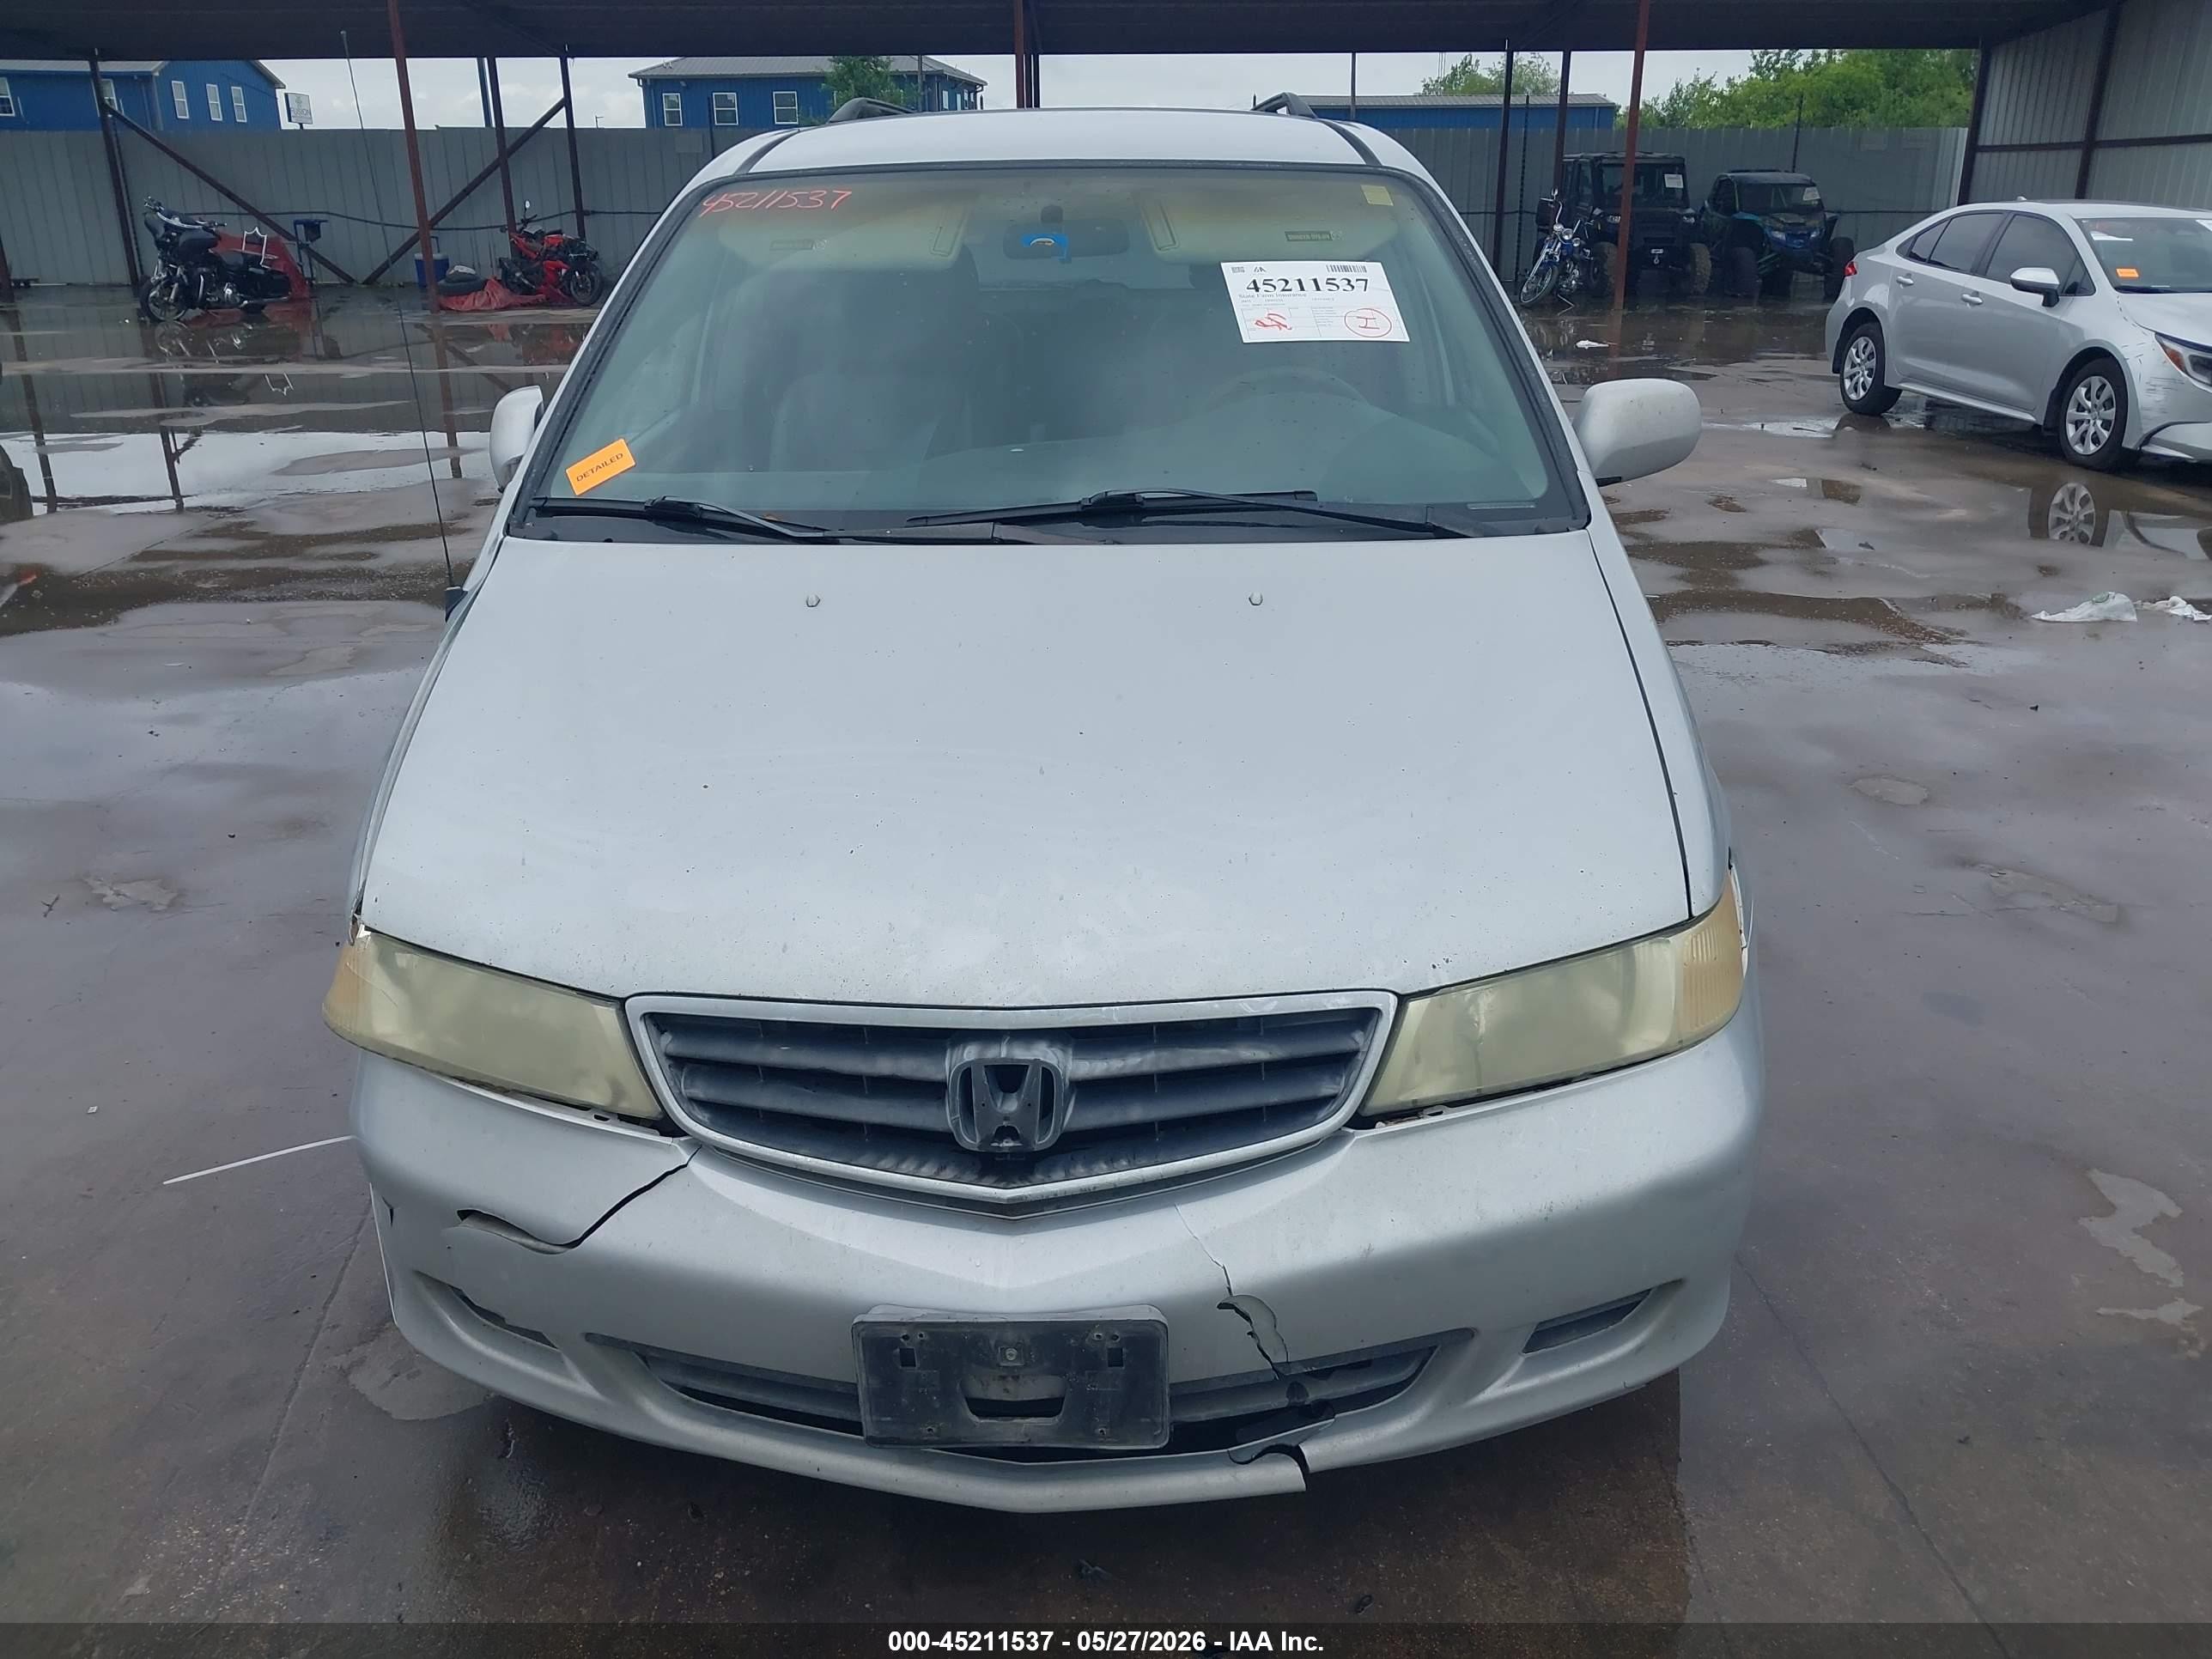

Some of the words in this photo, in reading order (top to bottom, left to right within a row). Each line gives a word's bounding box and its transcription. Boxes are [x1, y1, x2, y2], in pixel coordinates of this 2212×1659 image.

[699, 190, 853, 218] 45211537
[1246, 277, 1369, 293] 45211537
[576, 453, 623, 482] DETAILED
